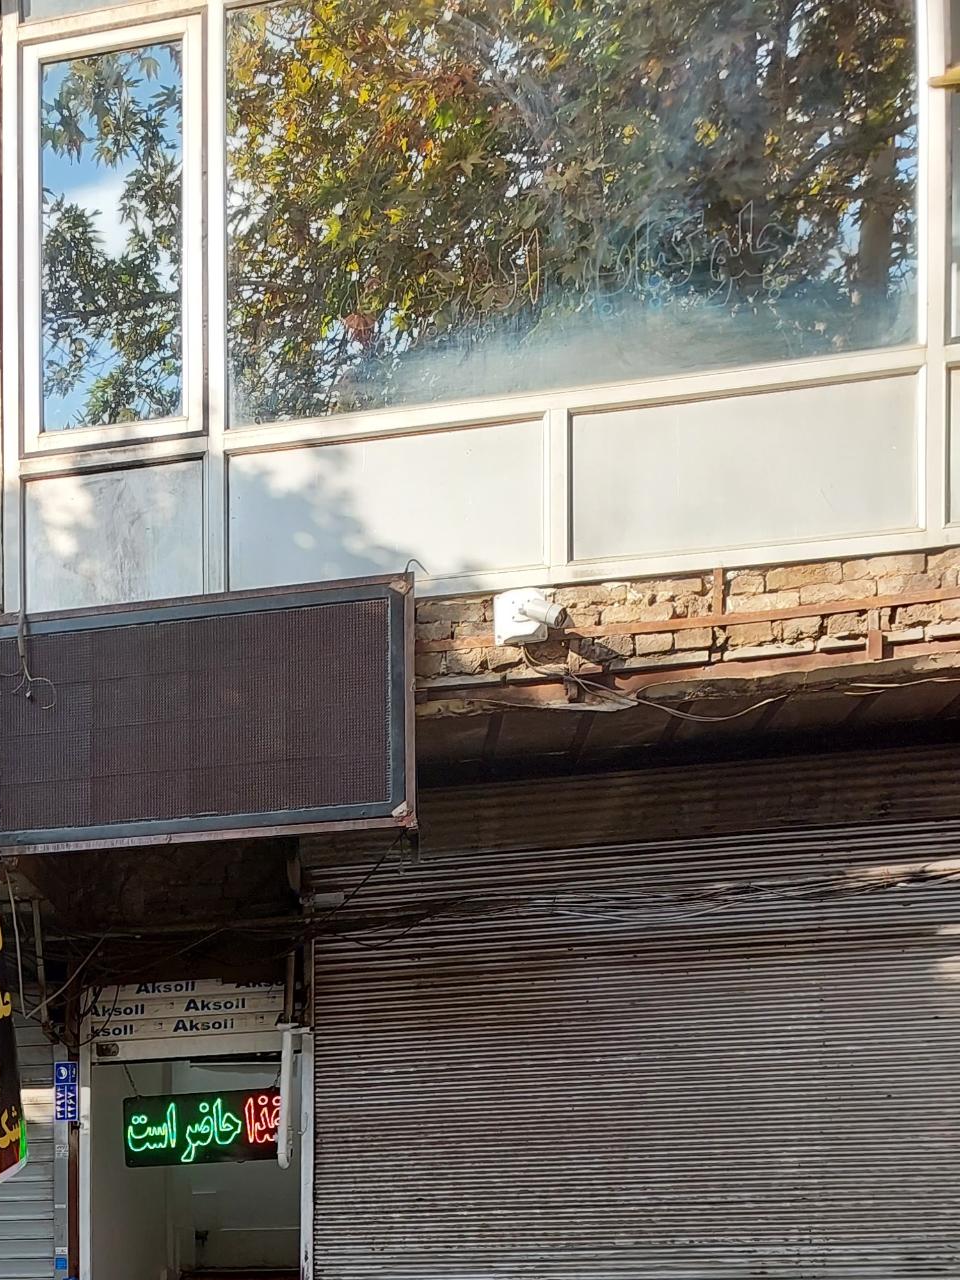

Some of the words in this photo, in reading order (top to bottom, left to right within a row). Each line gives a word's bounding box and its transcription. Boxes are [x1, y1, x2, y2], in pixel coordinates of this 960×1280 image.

[90, 1023, 134, 1037] ksoll
[127, 1102, 177, 1152] است
[180, 1098, 242, 1162] حاضر
